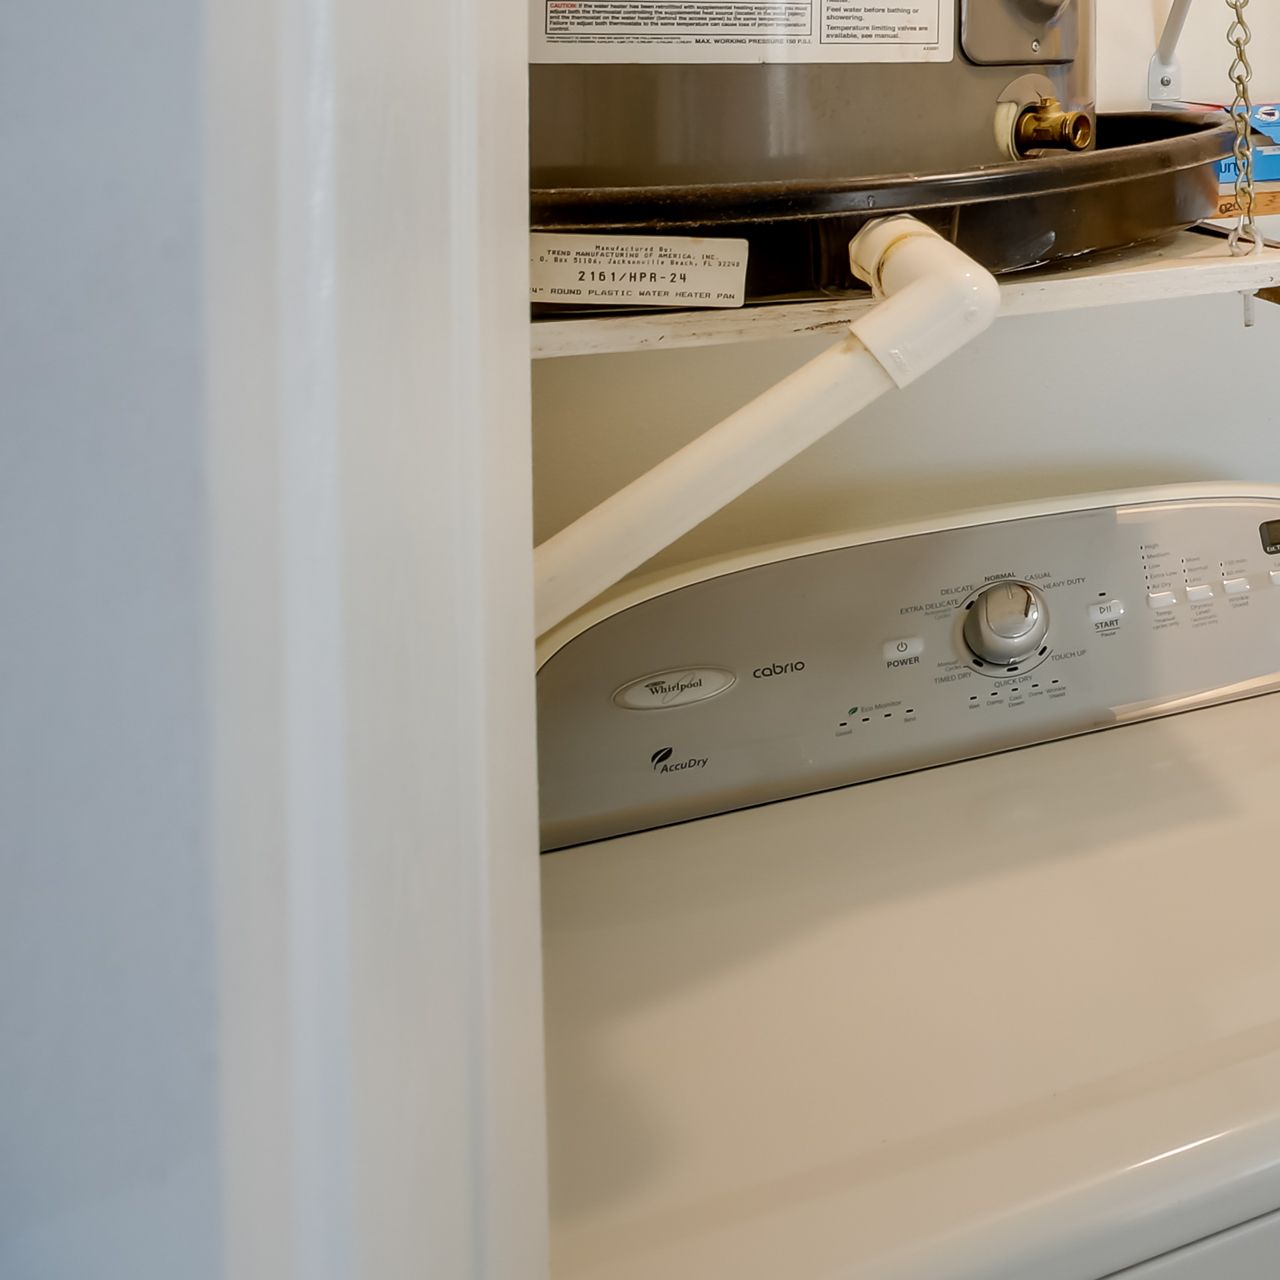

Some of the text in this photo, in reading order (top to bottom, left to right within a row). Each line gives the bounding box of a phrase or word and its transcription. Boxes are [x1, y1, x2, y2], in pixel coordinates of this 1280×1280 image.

[576, 251, 639, 259] MANUFACTURING
[608, 258, 664, 266] Jacksonville
[578, 271, 687, 283] 2161/HPR-24
[551, 288, 582, 296] ROUND
[588, 289, 632, 297] PLASTIC
[984, 572, 1016, 582] NORMAL
[1024, 572, 1051, 581] CASUAL
[1043, 577, 1086, 590] HEAVY DUTY
[941, 585, 973, 595] DELICATE
[900, 599, 959, 615] EXTRA DELICATE
[1094, 620, 1119, 630] START
[887, 656, 919, 668] POWER
[1051, 651, 1077, 661] TOUCH
[753, 661, 805, 678] cabrio
[934, 672, 972, 684] TIMED DRY
[994, 675, 1032, 688] QUICK DRY
[650, 679, 702, 696] Whirlpool
[661, 757, 708, 773] AccuDry
